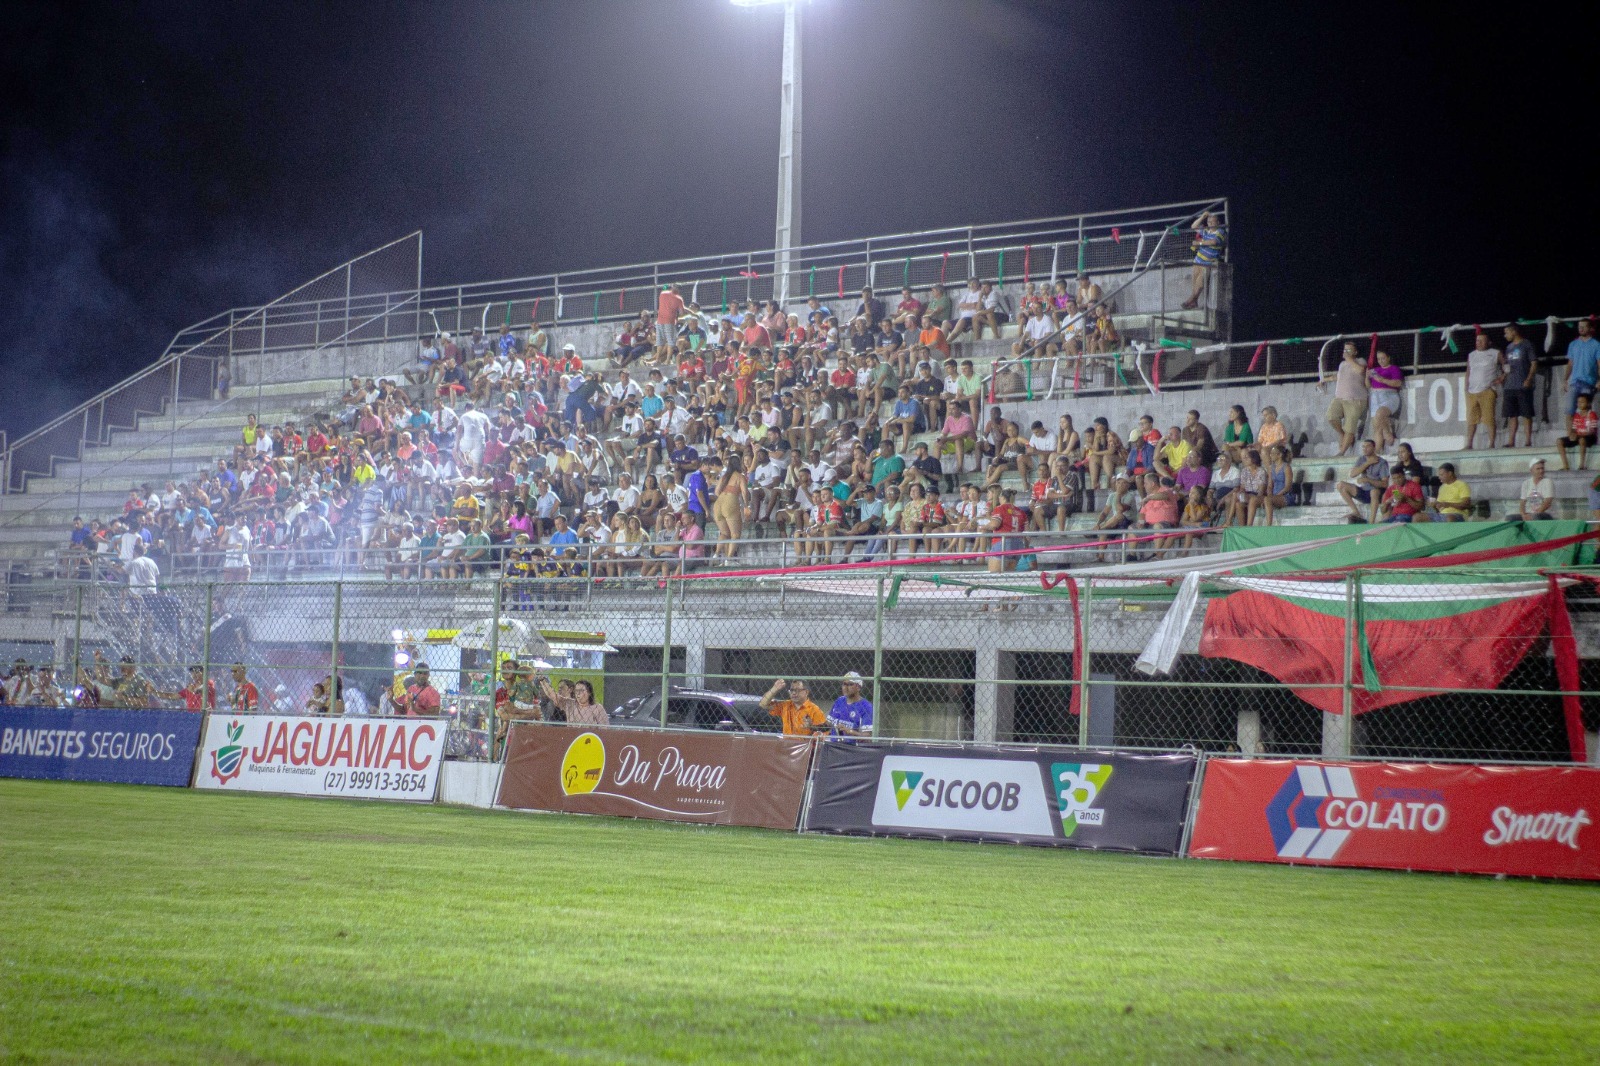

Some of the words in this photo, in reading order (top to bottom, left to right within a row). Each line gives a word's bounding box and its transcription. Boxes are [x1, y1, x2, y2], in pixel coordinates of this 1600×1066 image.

[1, 728, 86, 758] BANESTES
[88, 731, 176, 761] SEGUROS
[252, 721, 435, 771] JAGUAMAC
[282, 765, 316, 775] Ferramentas
[324, 772, 346, 791] (27)
[349, 772, 426, 792] 99913-3654
[613, 744, 652, 787] Da
[653, 746, 727, 793] Praça
[676, 797, 725, 806] supermercados
[918, 778, 1021, 812] SICOOB
[1059, 763, 1099, 819] 35
[1080, 811, 1100, 821] anos
[1324, 799, 1447, 832] COLATO
[1483, 806, 1592, 849] Smart
